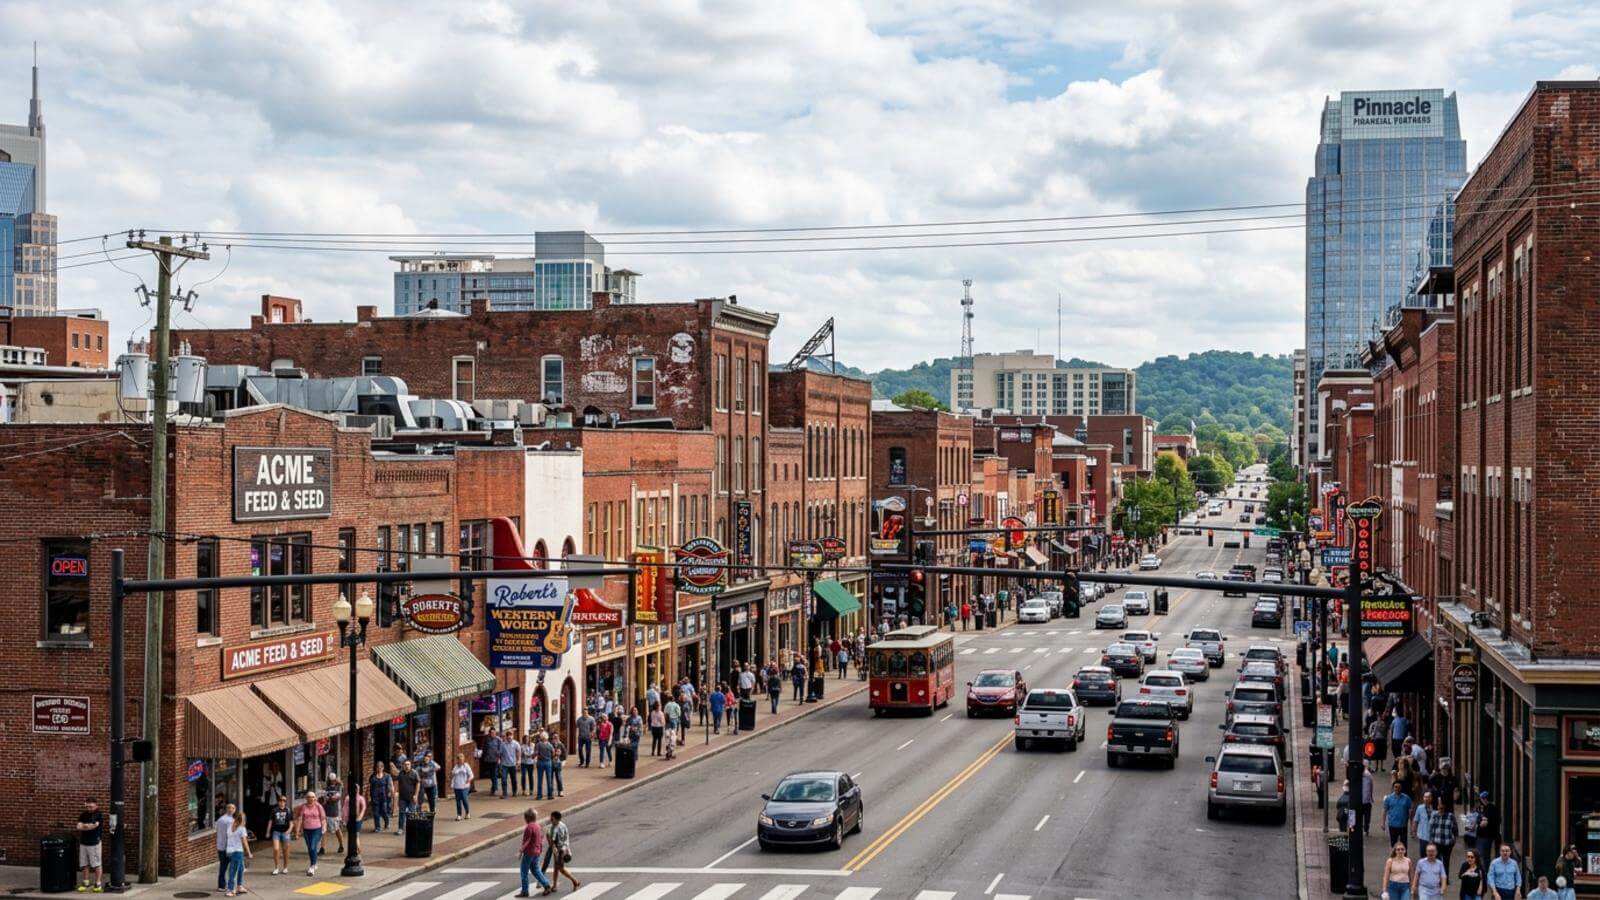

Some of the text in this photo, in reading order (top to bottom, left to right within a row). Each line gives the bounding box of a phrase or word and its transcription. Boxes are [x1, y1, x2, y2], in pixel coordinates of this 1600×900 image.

[1353, 95, 1432, 116] Pinnacle
[256, 454, 315, 485] ACME
[244, 489, 324, 512] FEED & SEED
[52, 559, 85, 573] OPEN
[494, 582, 558, 607] Robert's
[491, 609, 556, 620] WESTERN
[499, 620, 548, 630] WORLD
[231, 637, 323, 670] ACME FEED & SEED
